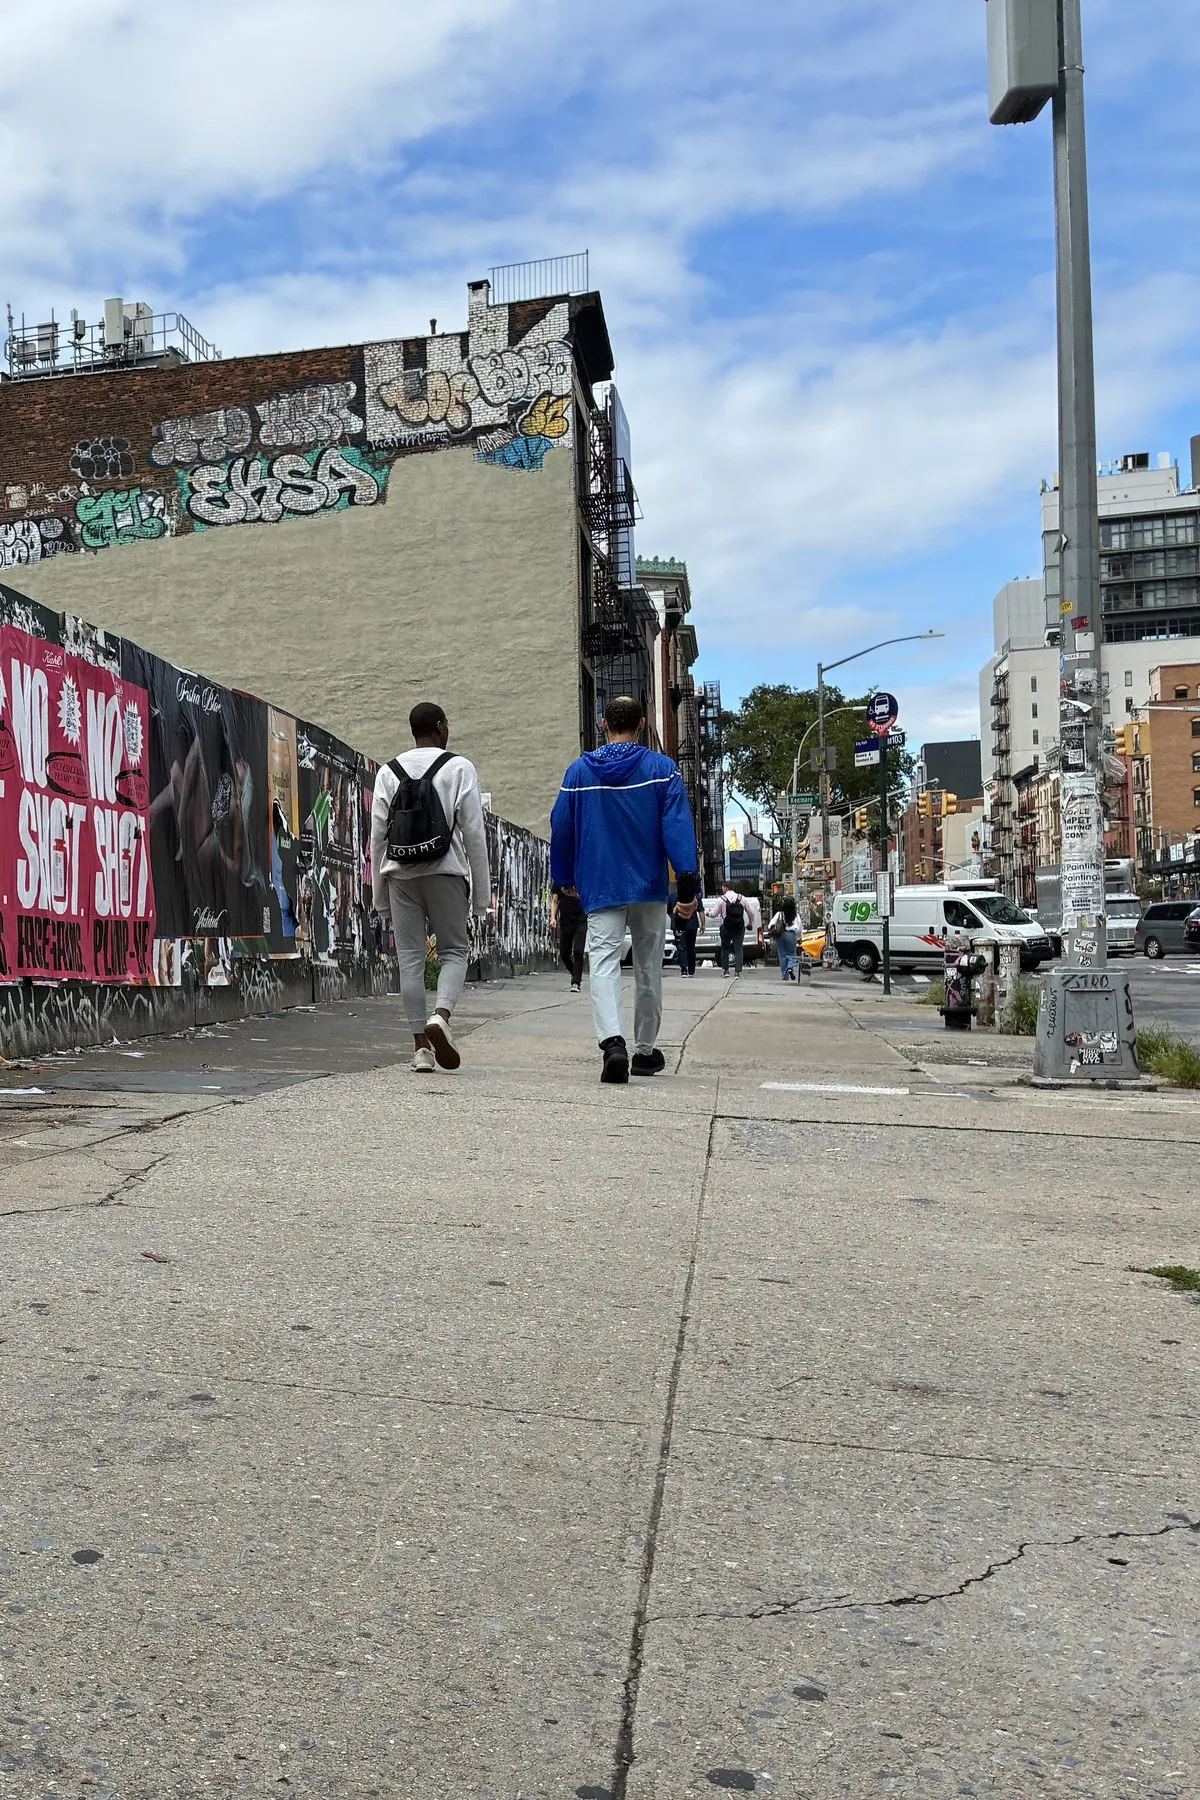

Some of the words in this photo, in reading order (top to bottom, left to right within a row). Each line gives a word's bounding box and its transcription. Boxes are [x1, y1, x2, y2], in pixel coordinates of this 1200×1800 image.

[11, 657, 50, 789] NO
[87, 688, 124, 804] NO
[887, 734, 903, 746] M103
[392, 840, 436, 856] TOMMY
